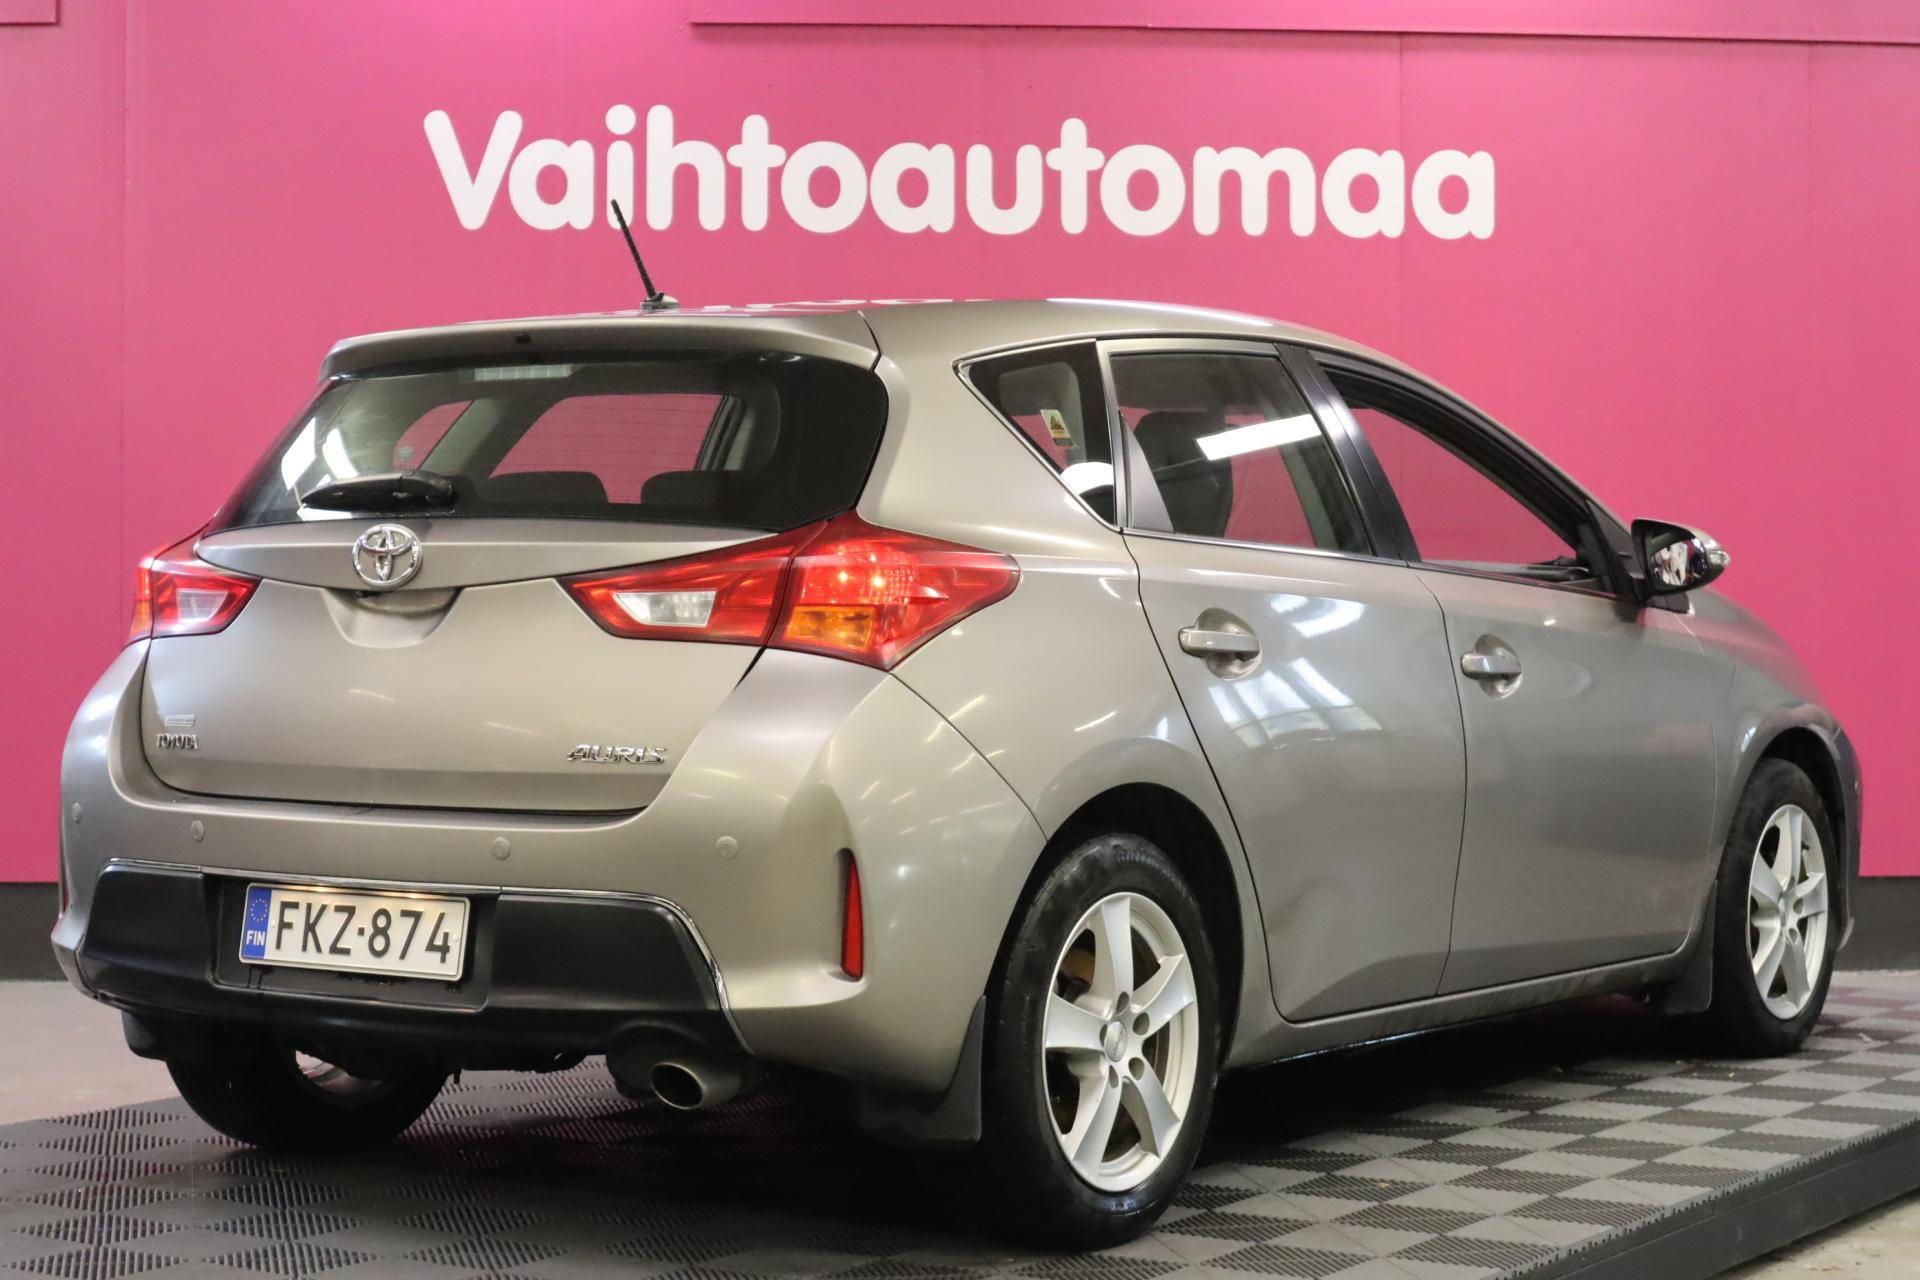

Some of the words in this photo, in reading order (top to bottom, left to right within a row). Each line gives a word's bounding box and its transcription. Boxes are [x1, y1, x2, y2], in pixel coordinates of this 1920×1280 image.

[423, 104, 1495, 239] Vaihtoautomaa
[156, 733, 198, 750] TOYOTA
[566, 743, 667, 764] AURIS
[245, 929, 266, 947] FIN
